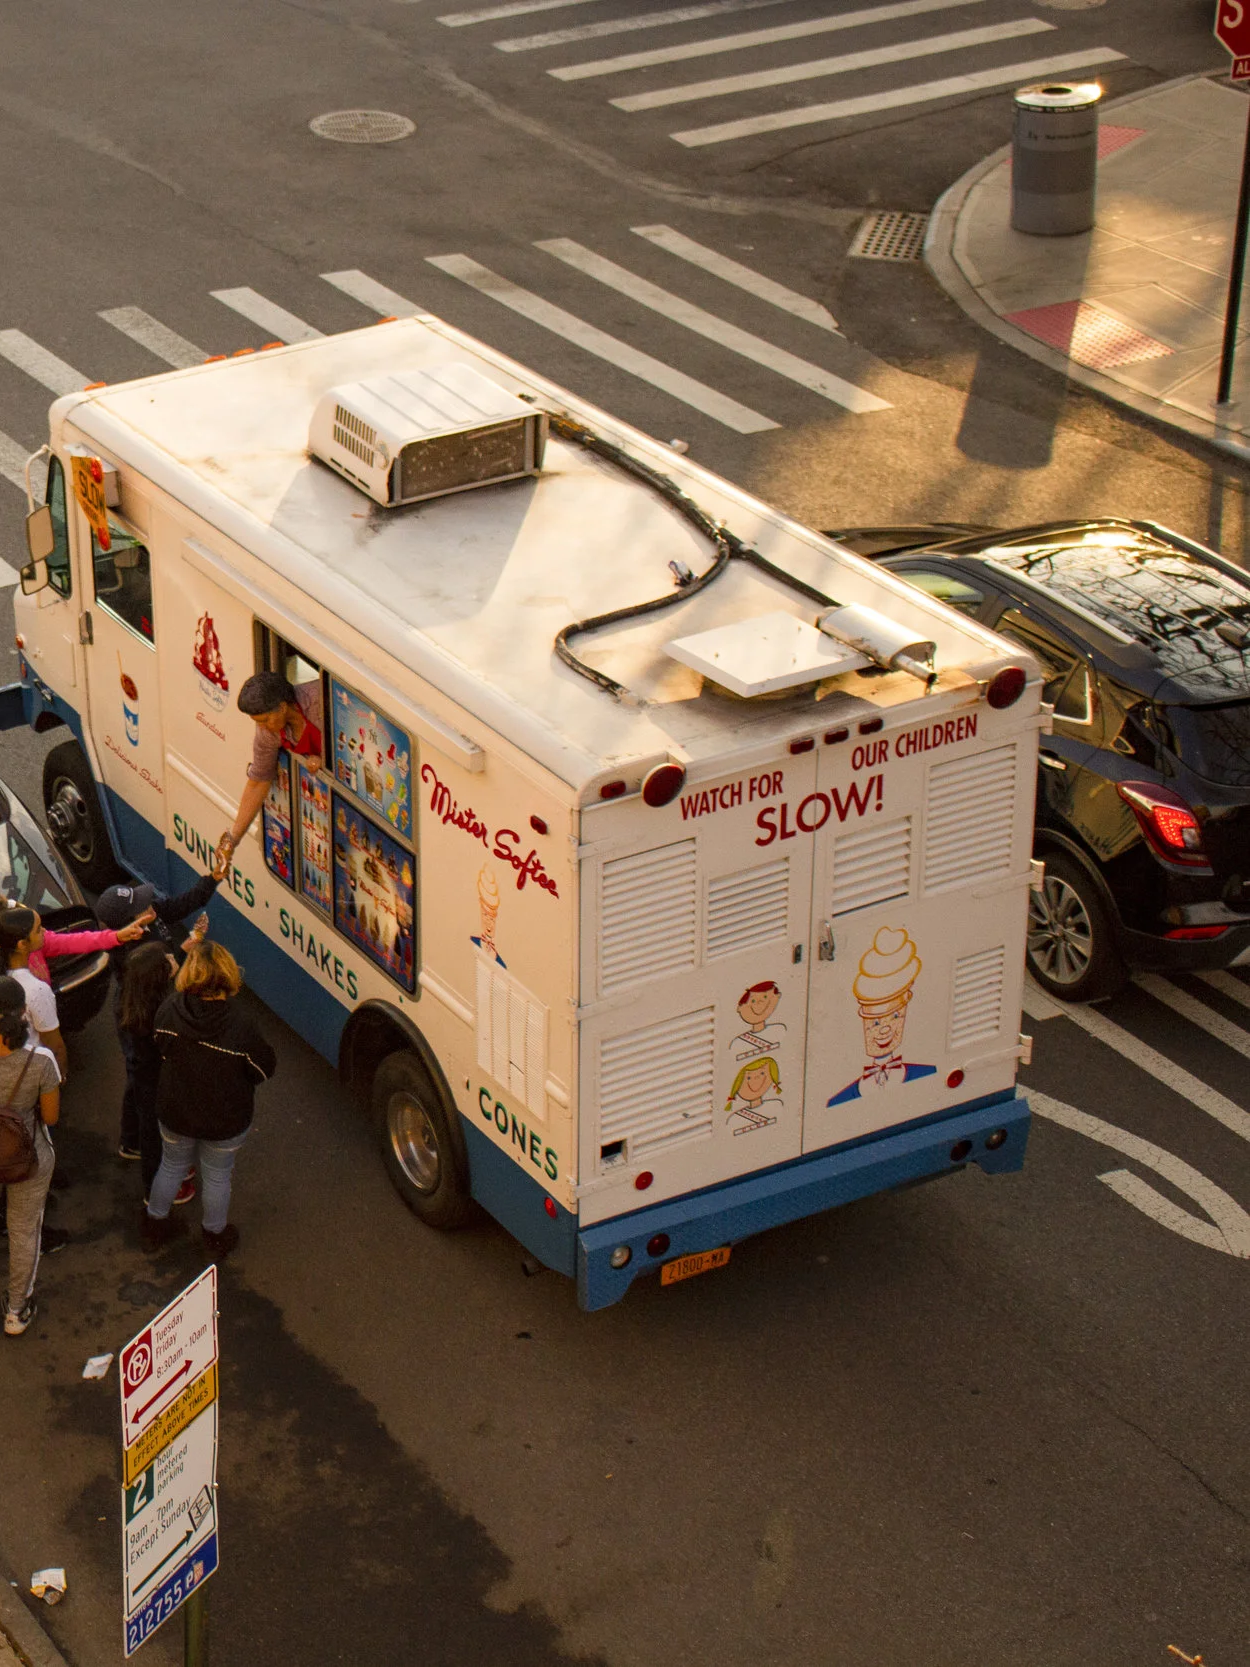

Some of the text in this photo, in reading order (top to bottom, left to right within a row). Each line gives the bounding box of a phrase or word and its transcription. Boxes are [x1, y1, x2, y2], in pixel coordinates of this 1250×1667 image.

[851, 713, 978, 771] OUR CHILDREN
[680, 770, 784, 821] WATCH FOR
[754, 773, 884, 847] SLOW!
[421, 763, 489, 848] Mister
[493, 829, 560, 900] Softee
[173, 812, 255, 908] SUNDES
[279, 907, 358, 1000] SHAKES
[479, 1086, 558, 1181] CONES
[155, 1311, 184, 1343] Tuesday
[155, 1333, 177, 1359] Friday
[156, 1346, 183, 1379] 8:30am
[189, 1324, 207, 1347] 10am
[133, 1388, 209, 1468] EFFECT ABOVE TIMES
[135, 1375, 206, 1451] METERS ARE NOT IN
[157, 1446, 174, 1468] hour
[157, 1444, 188, 1481] metered
[157, 1462, 184, 1496] parking
[132, 1471, 147, 1514] 2
[130, 1524, 148, 1548] 9am
[156, 1498, 174, 1520] 7pm
[130, 1527, 159, 1566] Except
[161, 1496, 191, 1534] Sunday
[130, 1579, 182, 1650] 212755
